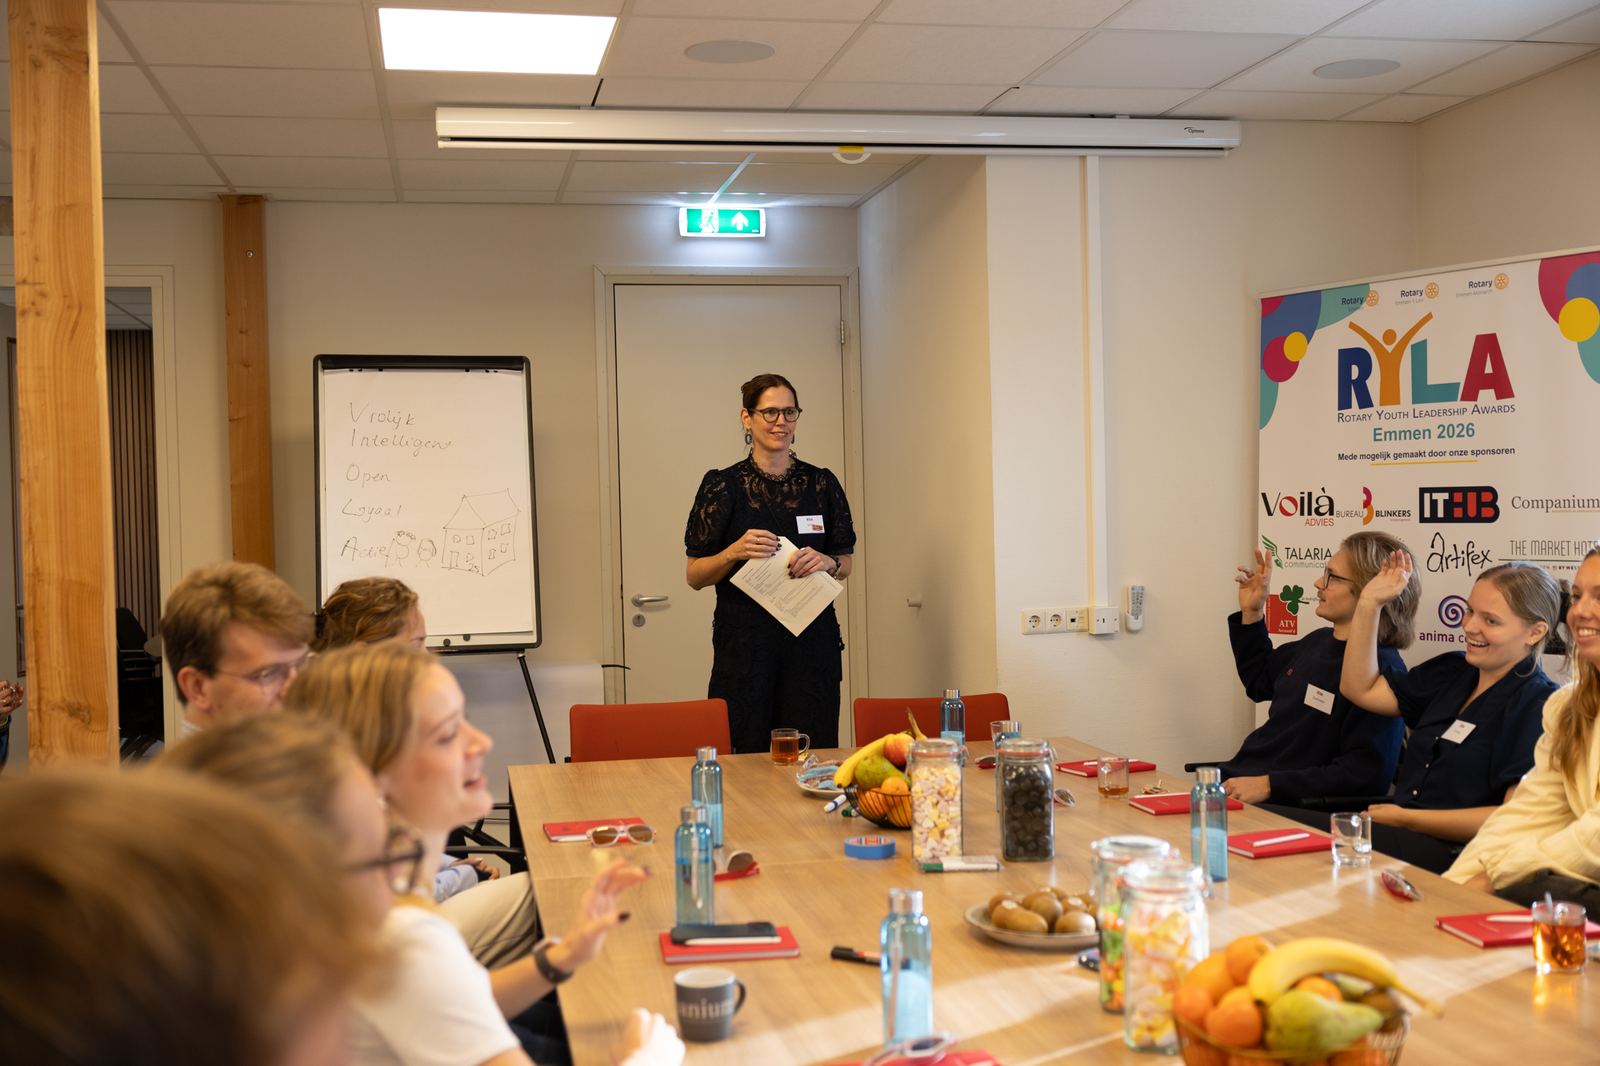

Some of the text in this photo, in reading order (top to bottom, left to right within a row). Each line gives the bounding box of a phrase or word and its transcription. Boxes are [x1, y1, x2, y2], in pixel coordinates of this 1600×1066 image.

[1468, 279, 1493, 289] Rotary
[1341, 296, 1364, 305] Rotary
[1400, 288, 1424, 298] Rotary
[1337, 312, 1515, 411] RYLA
[350, 402, 416, 429] Vrolijk
[1337, 403, 1516, 423] ROTARY YOUTH LEADERSHIP AWARDS
[1373, 422, 1476, 442] Emmen 2026
[1337, 447, 1516, 462] Mede mogelijk gemaakt door onze sponsoren
[345, 463, 391, 488] Open
[1261, 486, 1335, 517] Voilà
[1511, 494, 1600, 513] Companium
[1335, 509, 1412, 518] BUREAU BLINKERS
[1304, 517, 1335, 527] ADVIES
[1284, 547, 1333, 561] TALARIA
[1509, 540, 1528, 556] THE
[1530, 540, 1572, 556] MARKET
[1279, 619, 1296, 628] ATV
[1419, 630, 1455, 643] anima
